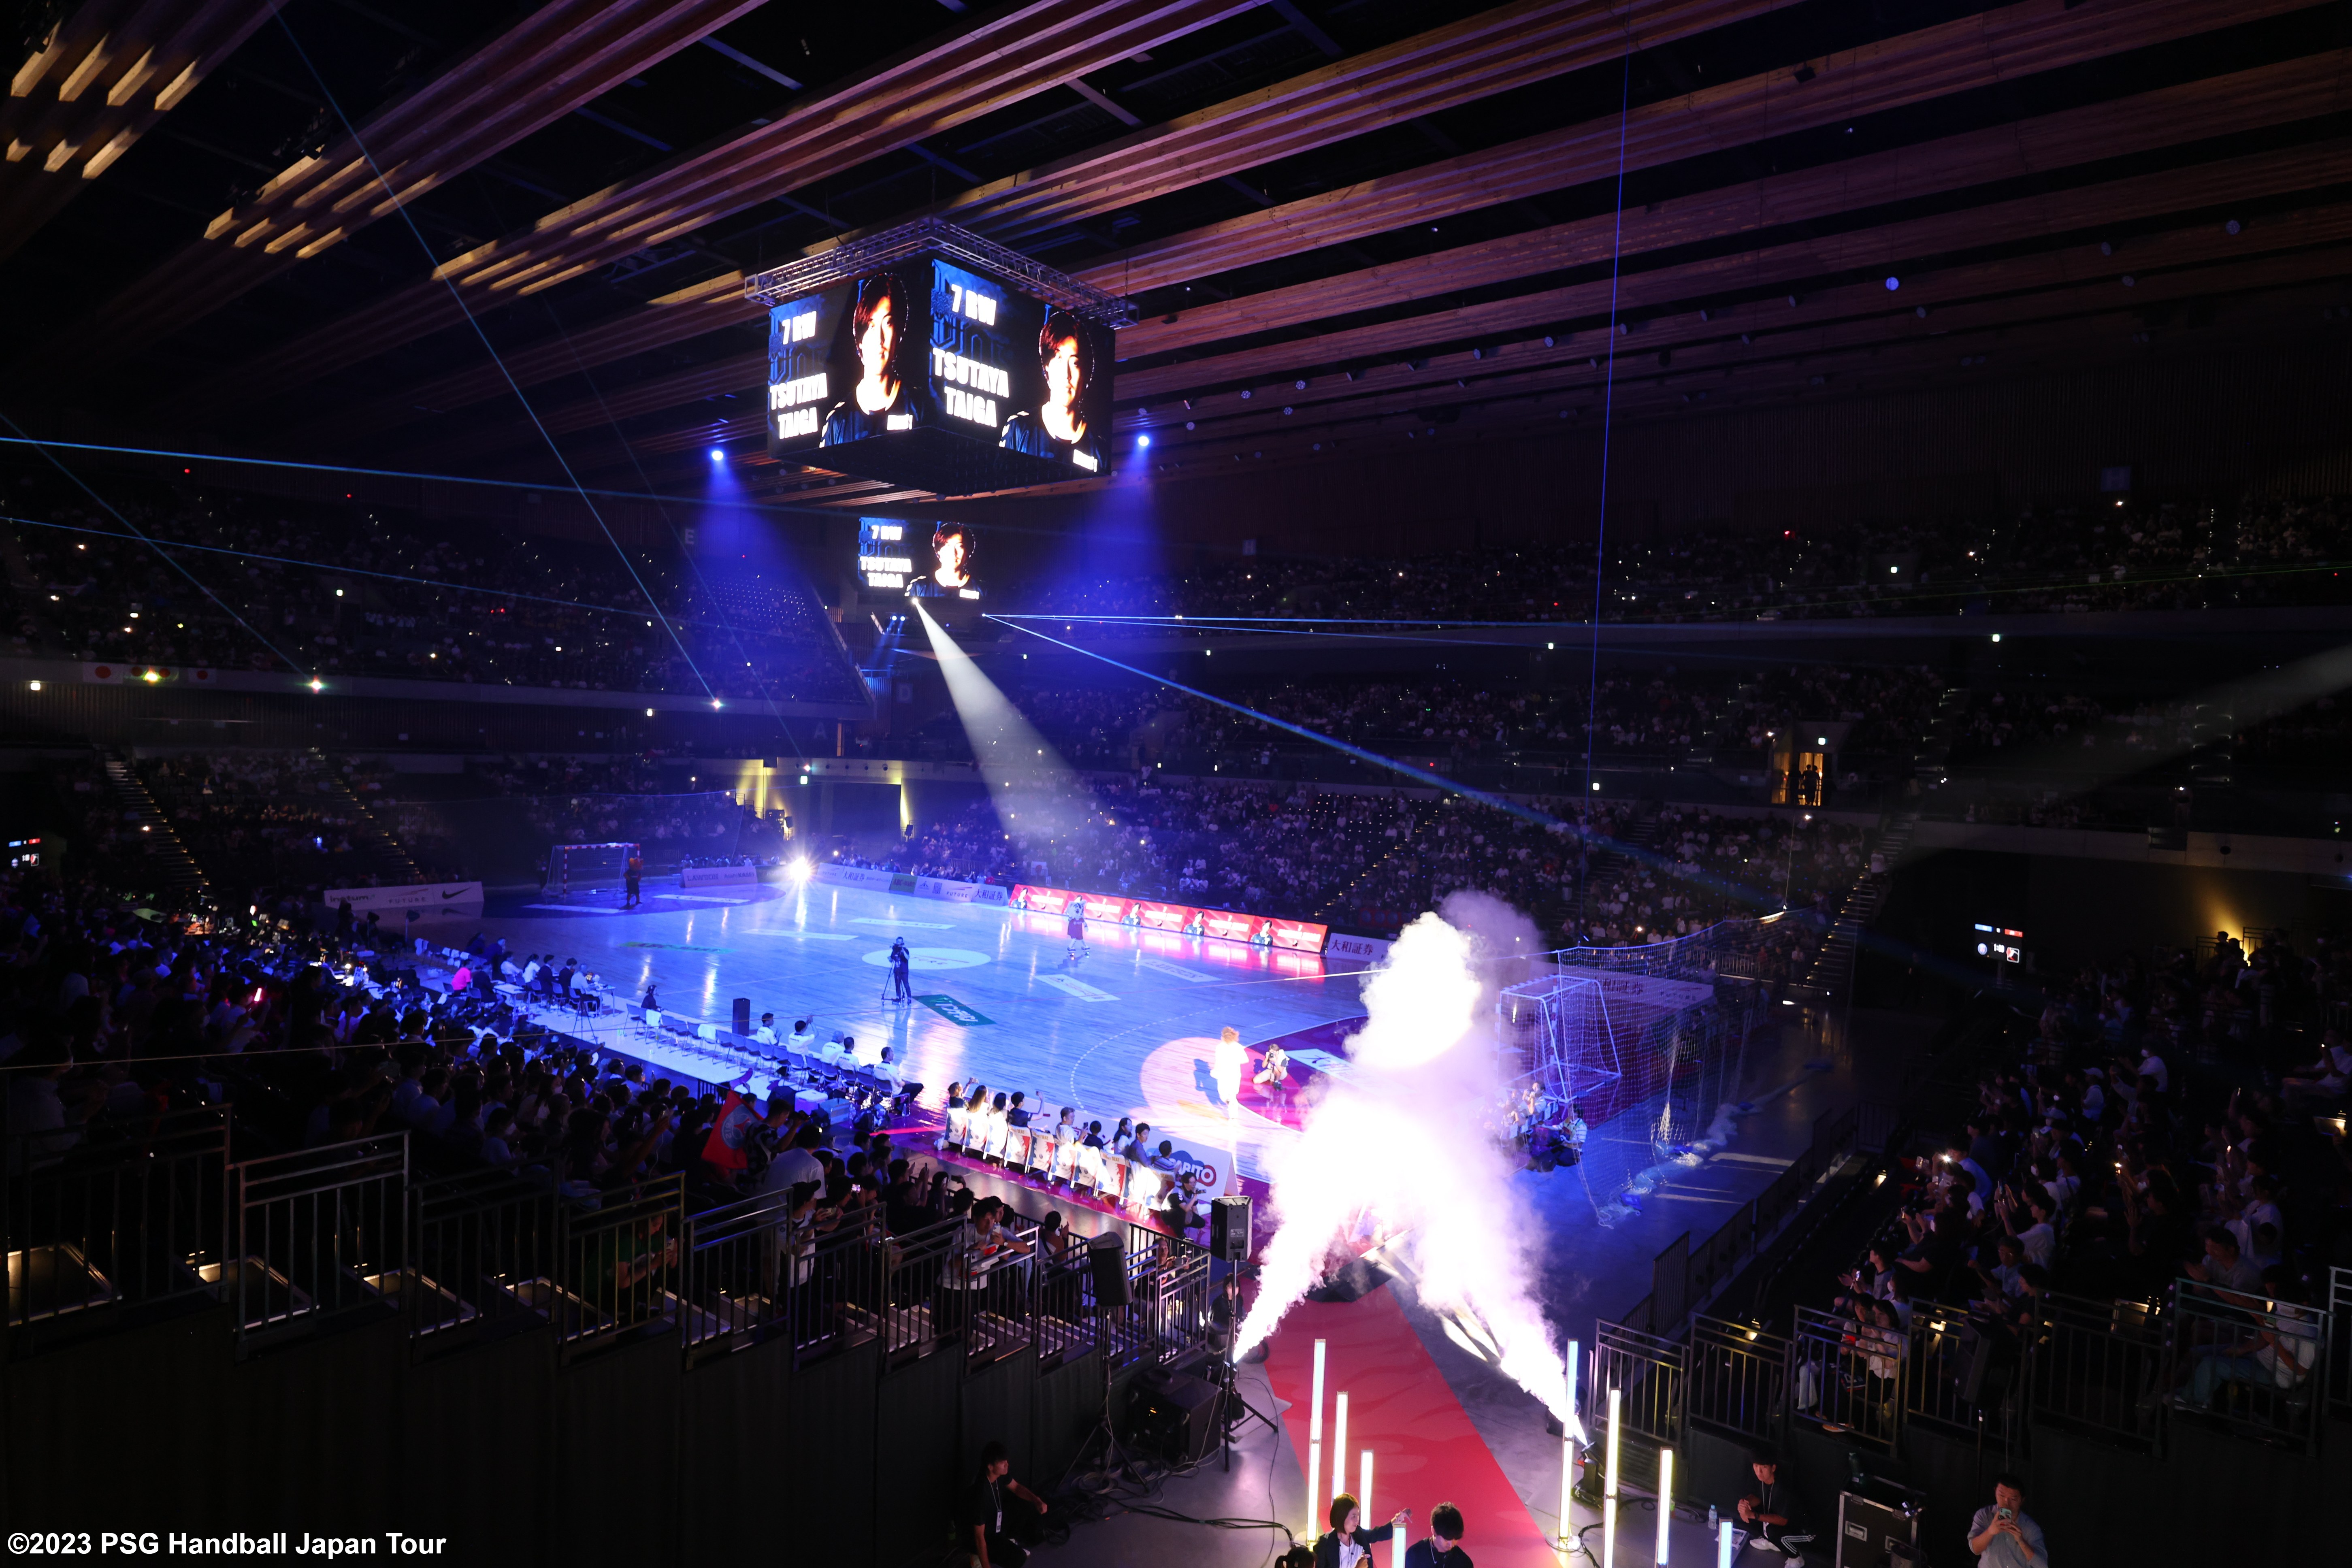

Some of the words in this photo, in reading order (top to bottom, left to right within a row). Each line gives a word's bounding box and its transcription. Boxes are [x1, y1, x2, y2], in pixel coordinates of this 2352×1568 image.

[951, 283, 962, 313] 7
[965, 290, 996, 326] RW
[782, 318, 790, 345] 7
[793, 311, 816, 342] RW
[933, 347, 1009, 398] TSUTAYA
[769, 372, 828, 410] TSUTAYA
[944, 386, 997, 427] TAIGA
[778, 407, 818, 439] TAIGA
[871, 525, 879, 539] 7
[899, 684, 910, 701] D
[814, 722, 826, 739] A
[975, 889, 1003, 901] 大和証券
[1331, 939, 1373, 956] 大和証券
